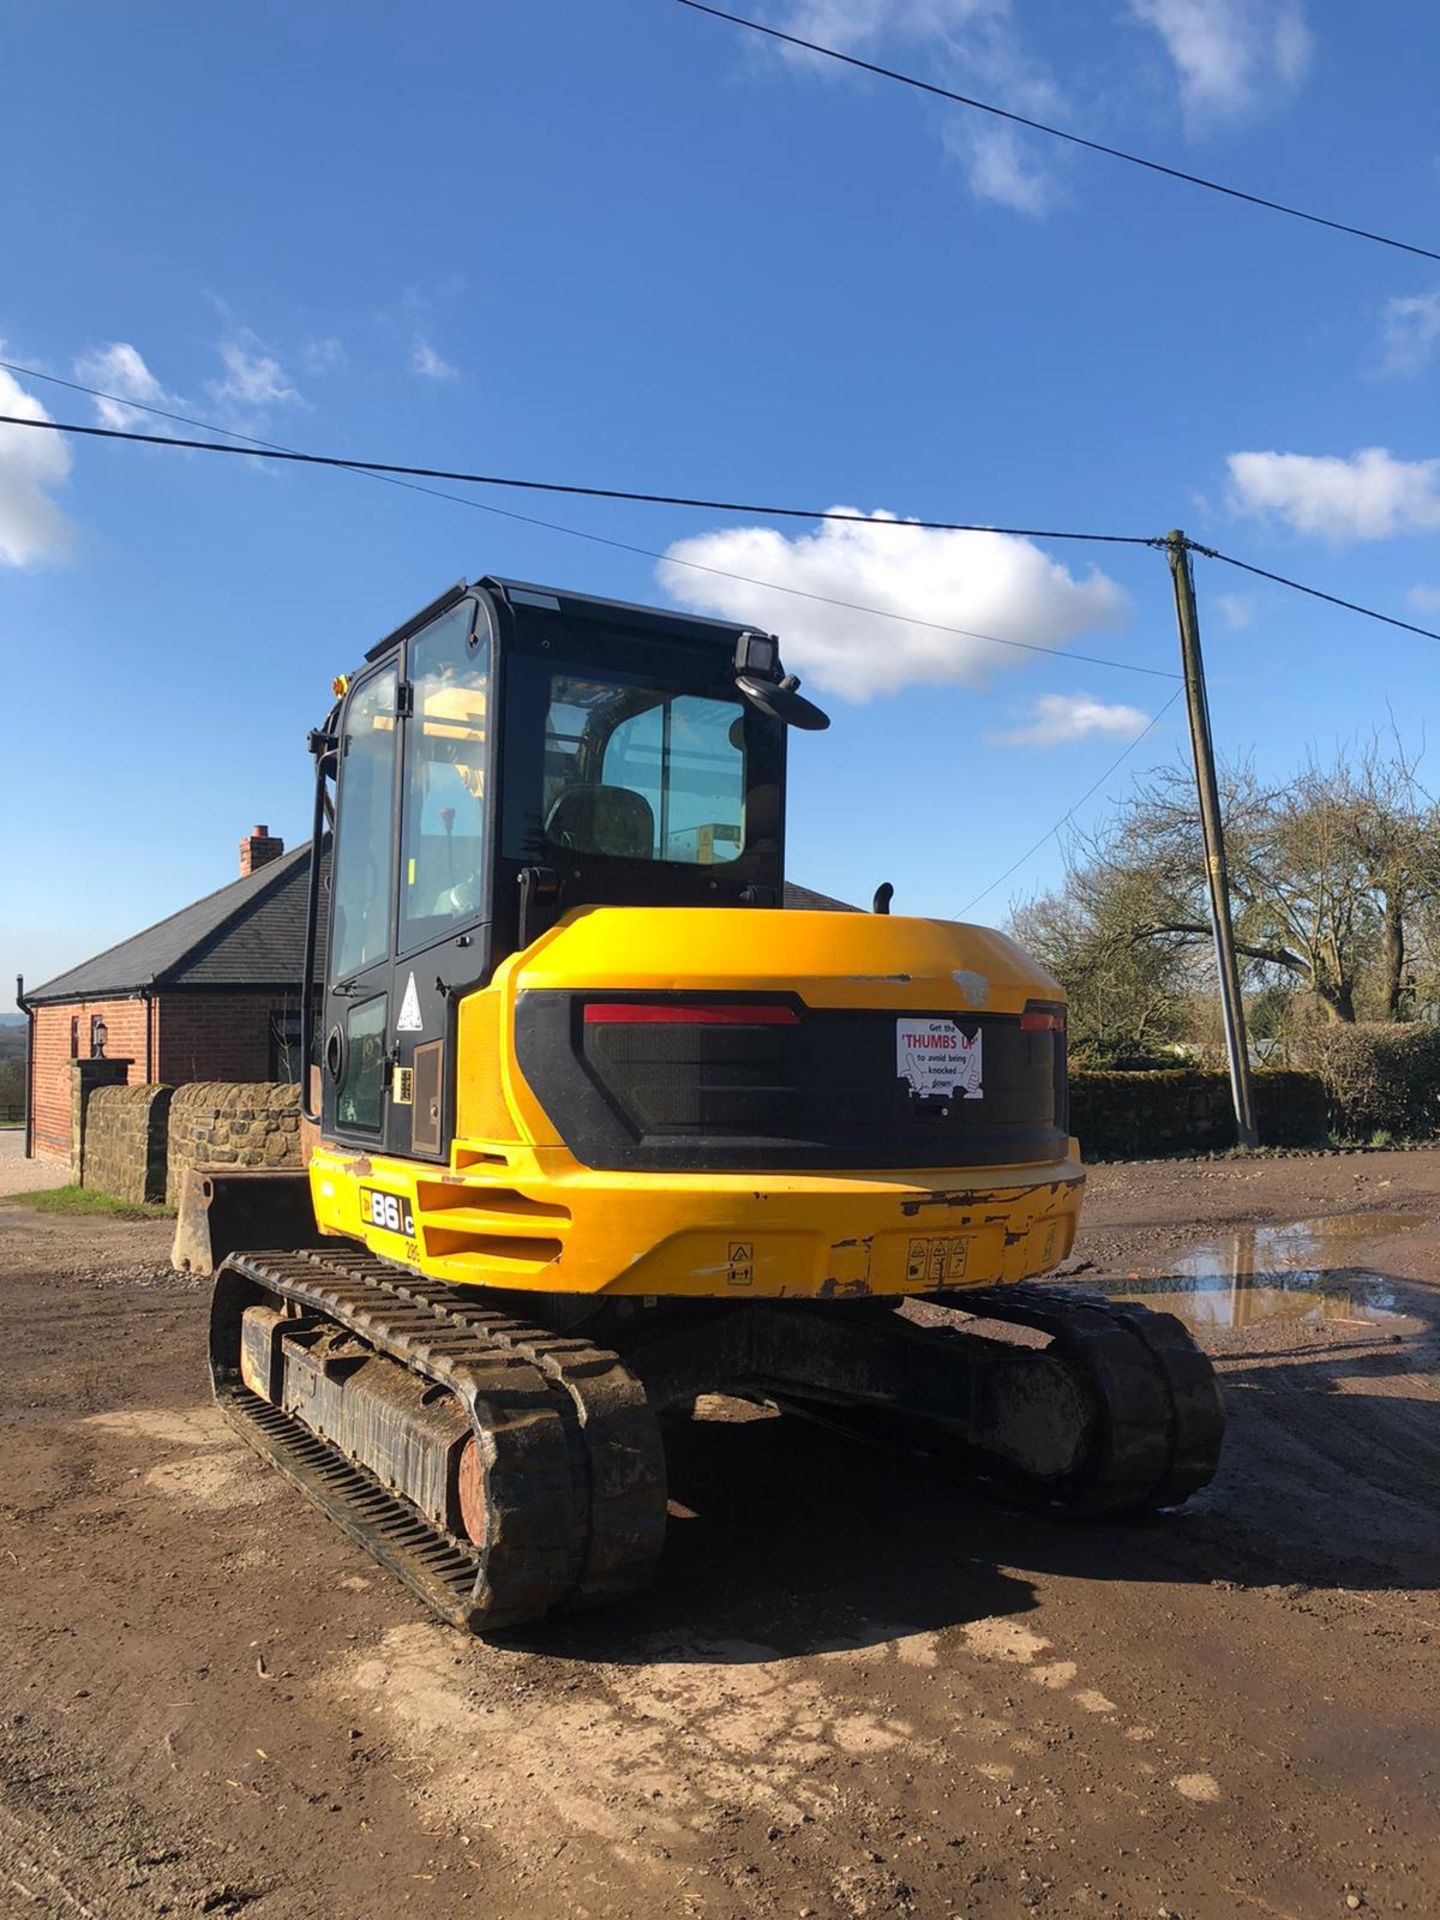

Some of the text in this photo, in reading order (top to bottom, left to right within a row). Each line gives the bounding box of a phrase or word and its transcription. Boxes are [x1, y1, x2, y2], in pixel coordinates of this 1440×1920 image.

[929, 1023, 956, 1032] Get the
[917, 1054, 967, 1065] to avoid being
[928, 1065, 957, 1075] knocked
[371, 1191, 399, 1230] 86
